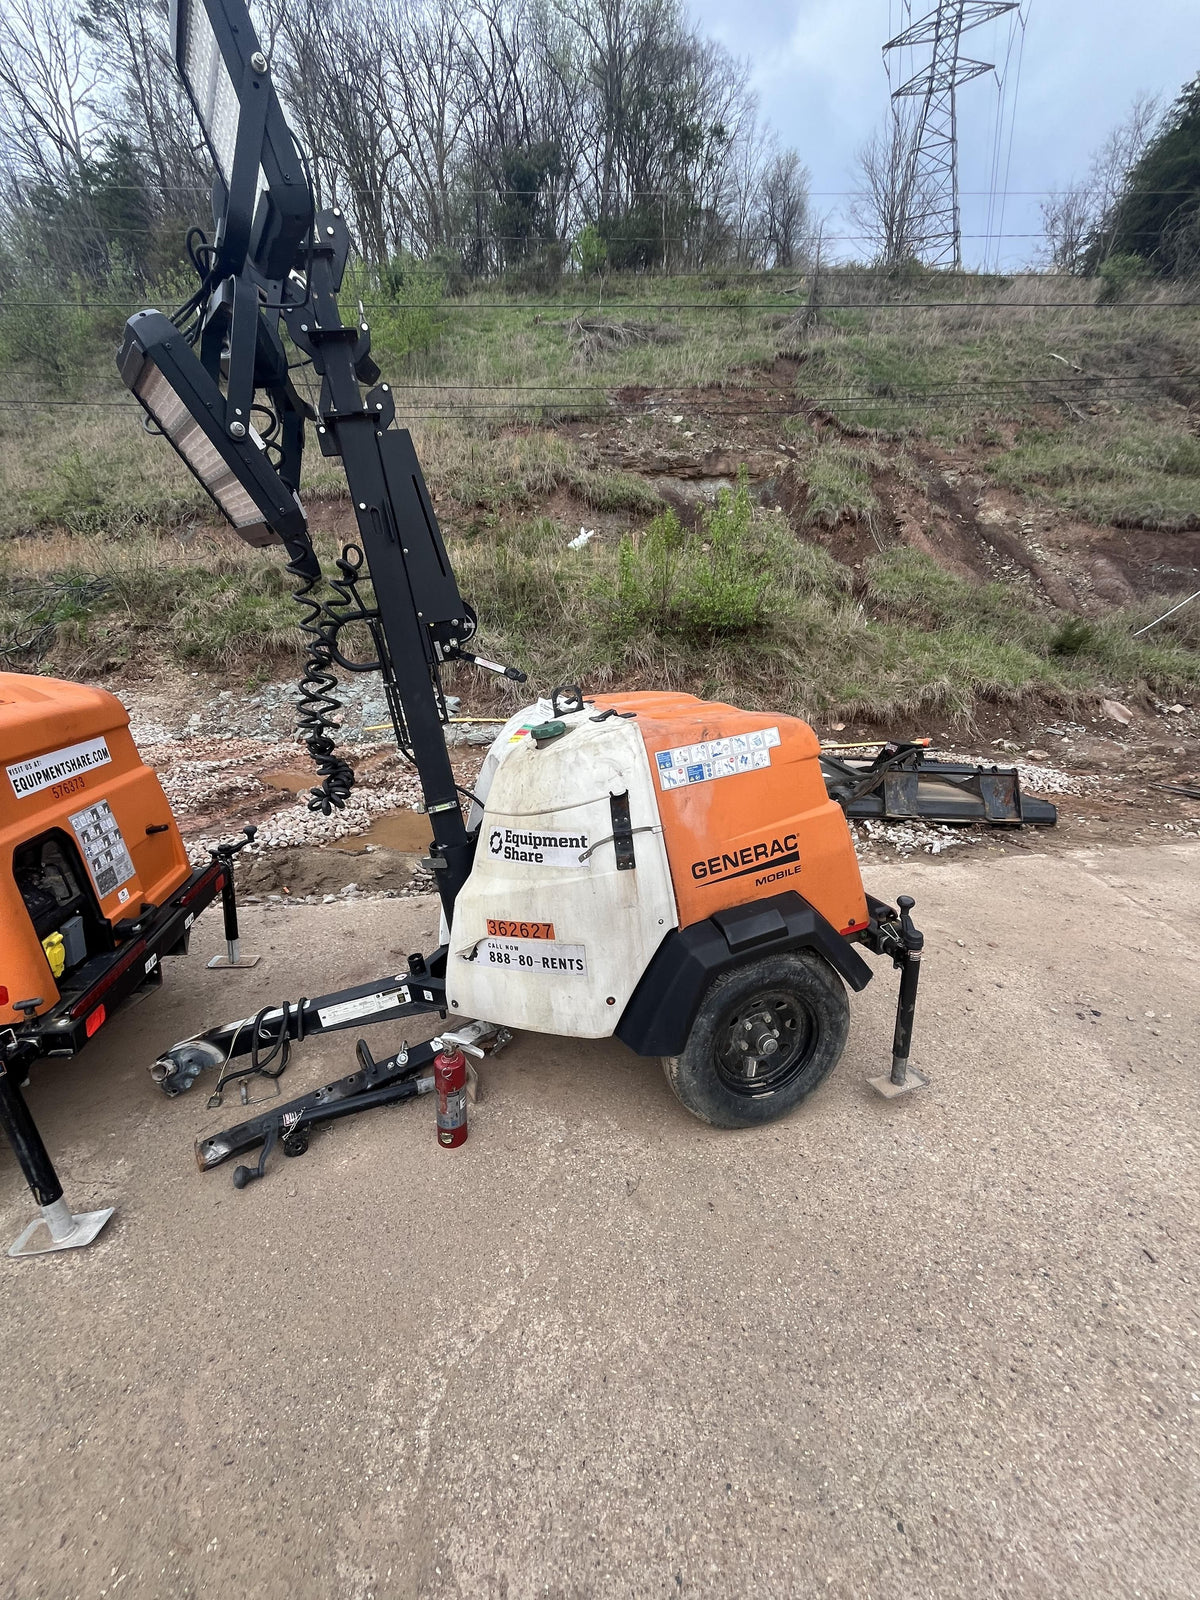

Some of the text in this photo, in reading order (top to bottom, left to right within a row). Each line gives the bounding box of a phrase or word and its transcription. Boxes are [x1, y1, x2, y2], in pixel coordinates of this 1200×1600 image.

[8, 766, 23, 776] VISIT
[25, 763, 32, 771] US
[12, 747, 110, 793] EQUIPMENTSHARE.COM
[51, 776, 85, 799] 576373
[504, 829, 588, 849] Equipment
[503, 846, 544, 863] Share
[691, 834, 798, 879] GENERAC
[755, 865, 802, 886] MOBILE
[488, 920, 551, 939] 362627
[488, 942, 503, 950] CALL
[489, 951, 584, 971] 888-80-RENTS
